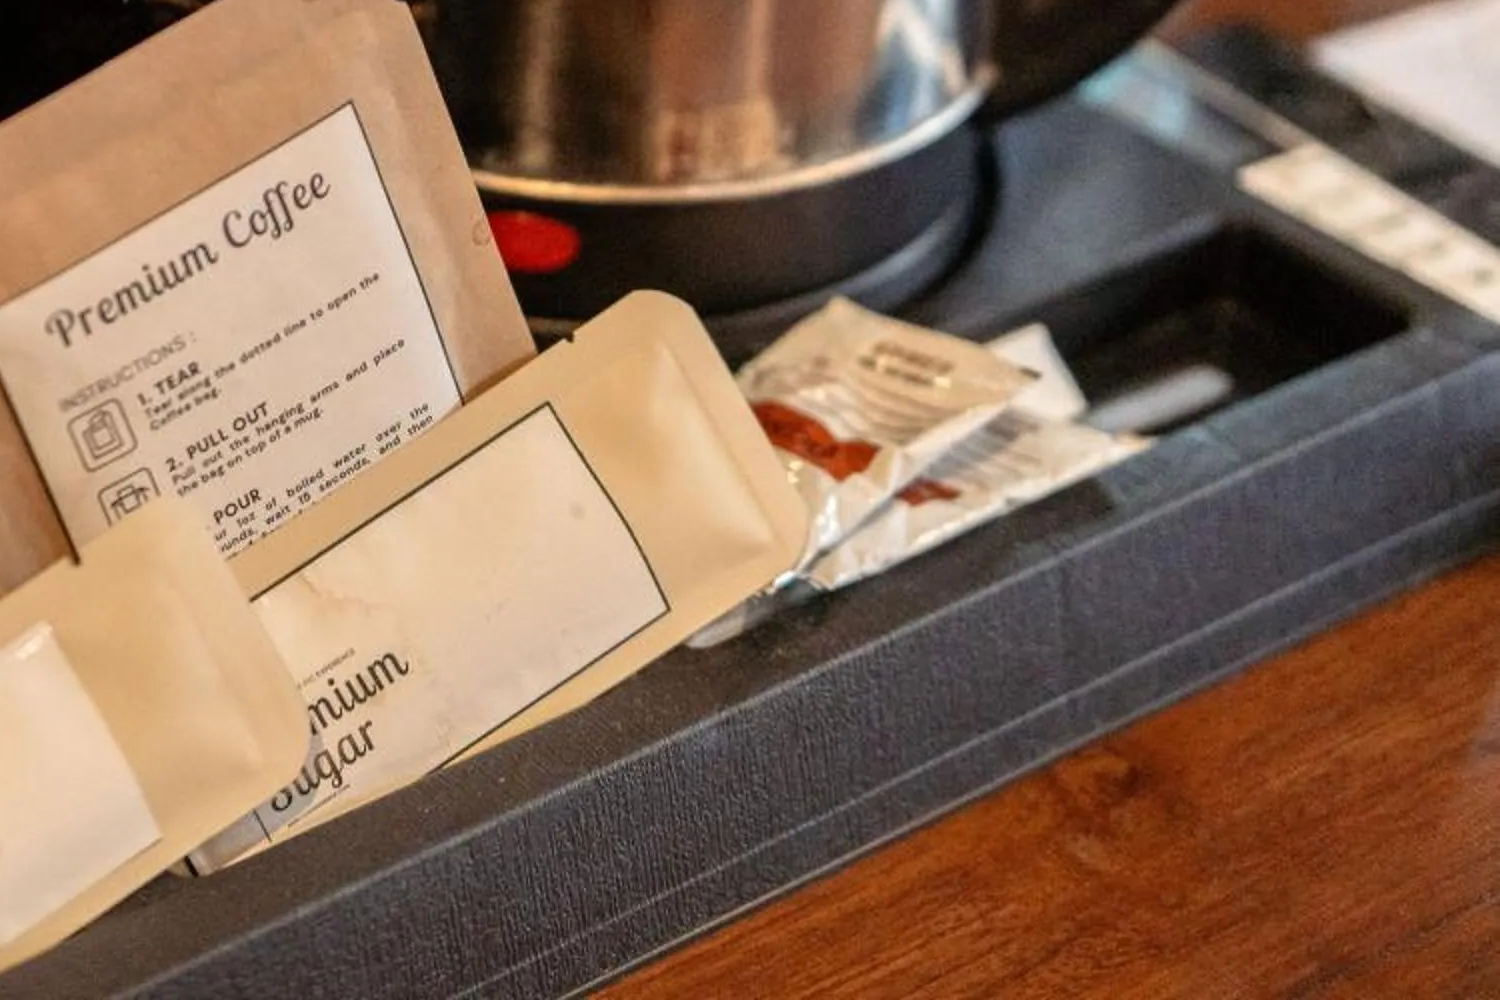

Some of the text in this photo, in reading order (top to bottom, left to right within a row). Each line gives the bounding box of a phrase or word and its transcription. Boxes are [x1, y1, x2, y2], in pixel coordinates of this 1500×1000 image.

[44, 172, 331, 348] Premium Coffee
[154, 361, 200, 394] TEAR
[178, 377, 211, 400] along
[215, 362, 236, 378] the
[239, 332, 281, 364] dotted
[283, 319, 307, 337] line
[310, 308, 324, 321] to
[327, 287, 357, 310] open
[359, 273, 379, 290] the
[150, 403, 191, 431] Coffee
[165, 401, 267, 472] 2. PULL OUT
[172, 339, 404, 484] Pull out the hanging arms and place
[177, 407, 323, 497] the bag on top of a mug.
[265, 497, 277, 510] of
[286, 468, 324, 497] boiled
[332, 443, 366, 468] water
[375, 421, 402, 442] over
[409, 403, 429, 419] the
[213, 489, 261, 524] POUR
[266, 504, 291, 525] wait
[379, 435, 402, 455] and
[407, 415, 433, 436] then
[308, 652, 409, 736] mium
